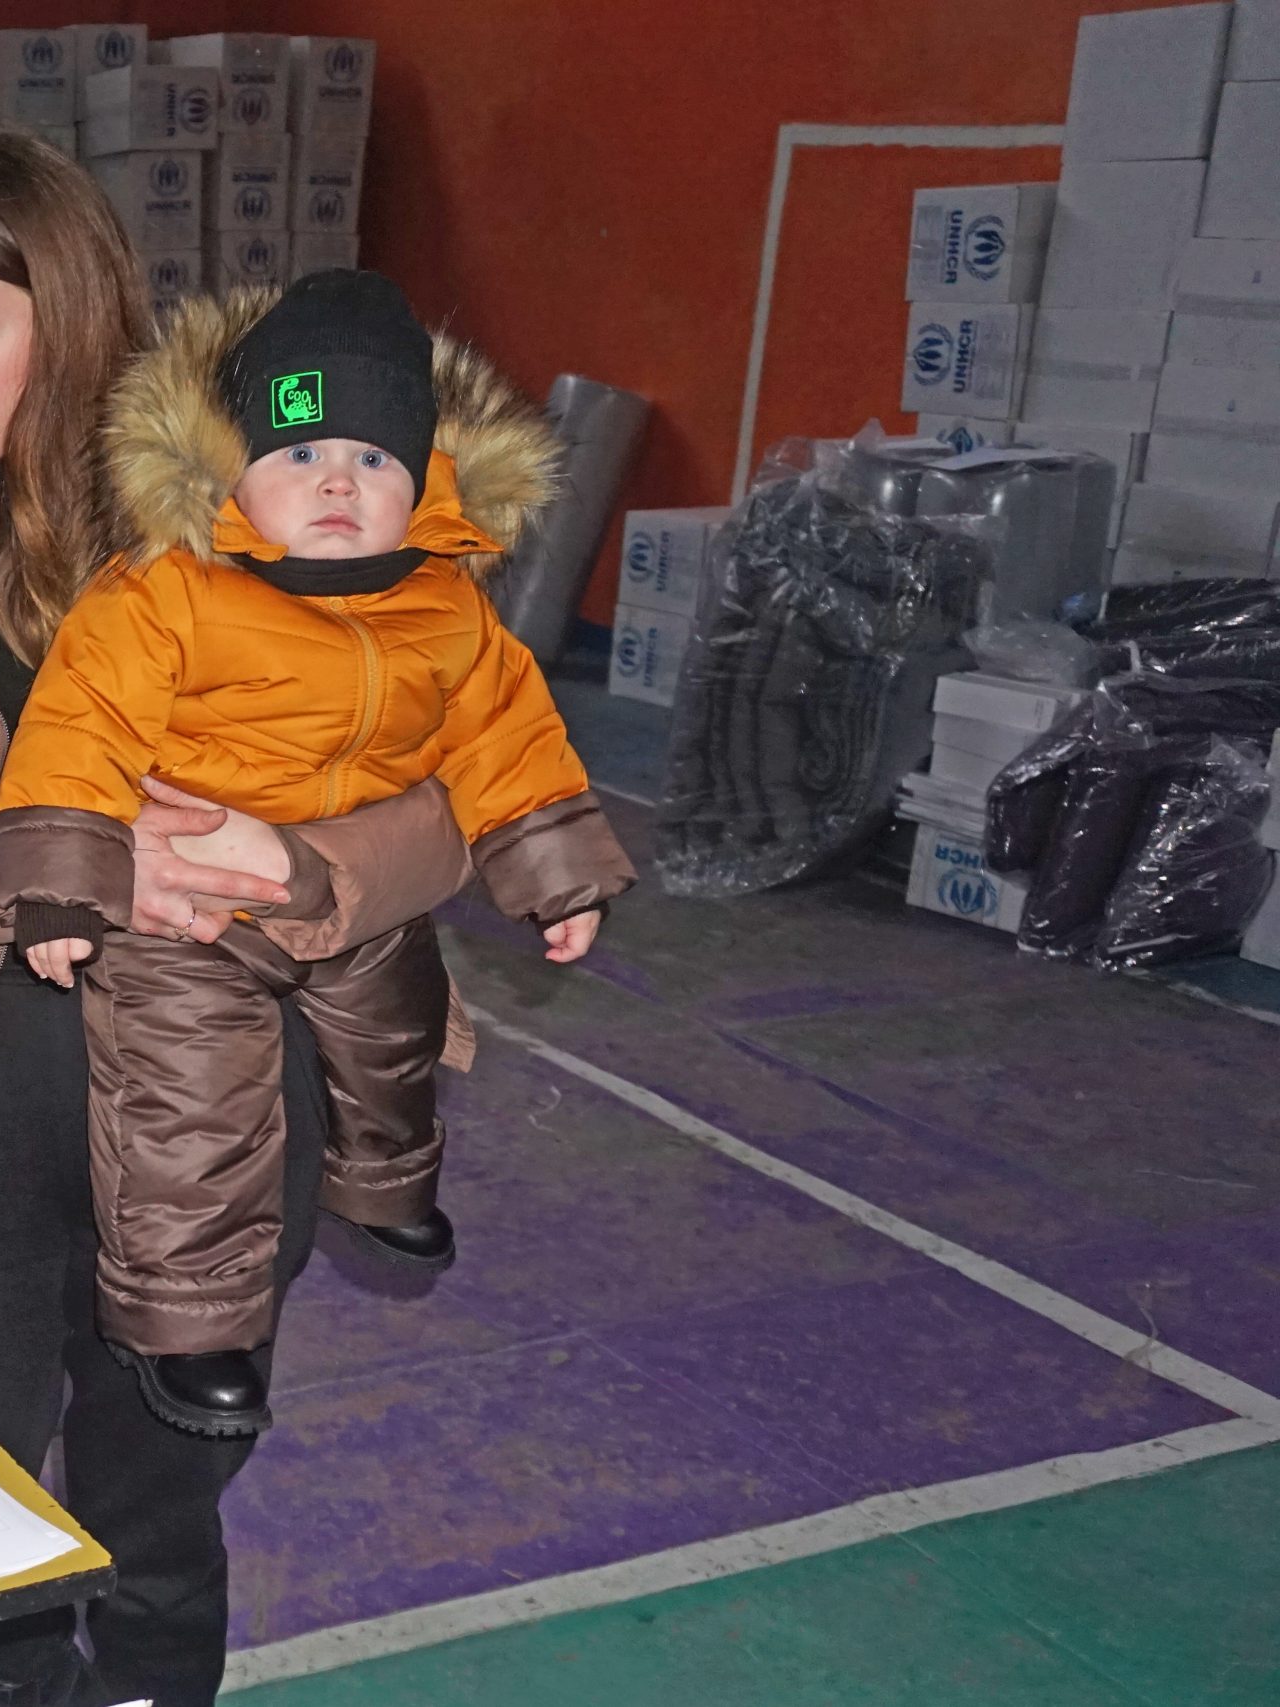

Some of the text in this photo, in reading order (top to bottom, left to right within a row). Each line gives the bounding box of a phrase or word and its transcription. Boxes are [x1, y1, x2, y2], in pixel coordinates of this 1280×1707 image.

[944, 210, 964, 284] UNHCR
[953, 320, 974, 394] UNHCR
[287, 390, 317, 410] COOL
[656, 531, 673, 592] UNHCR
[643, 627, 659, 687] UNHCR
